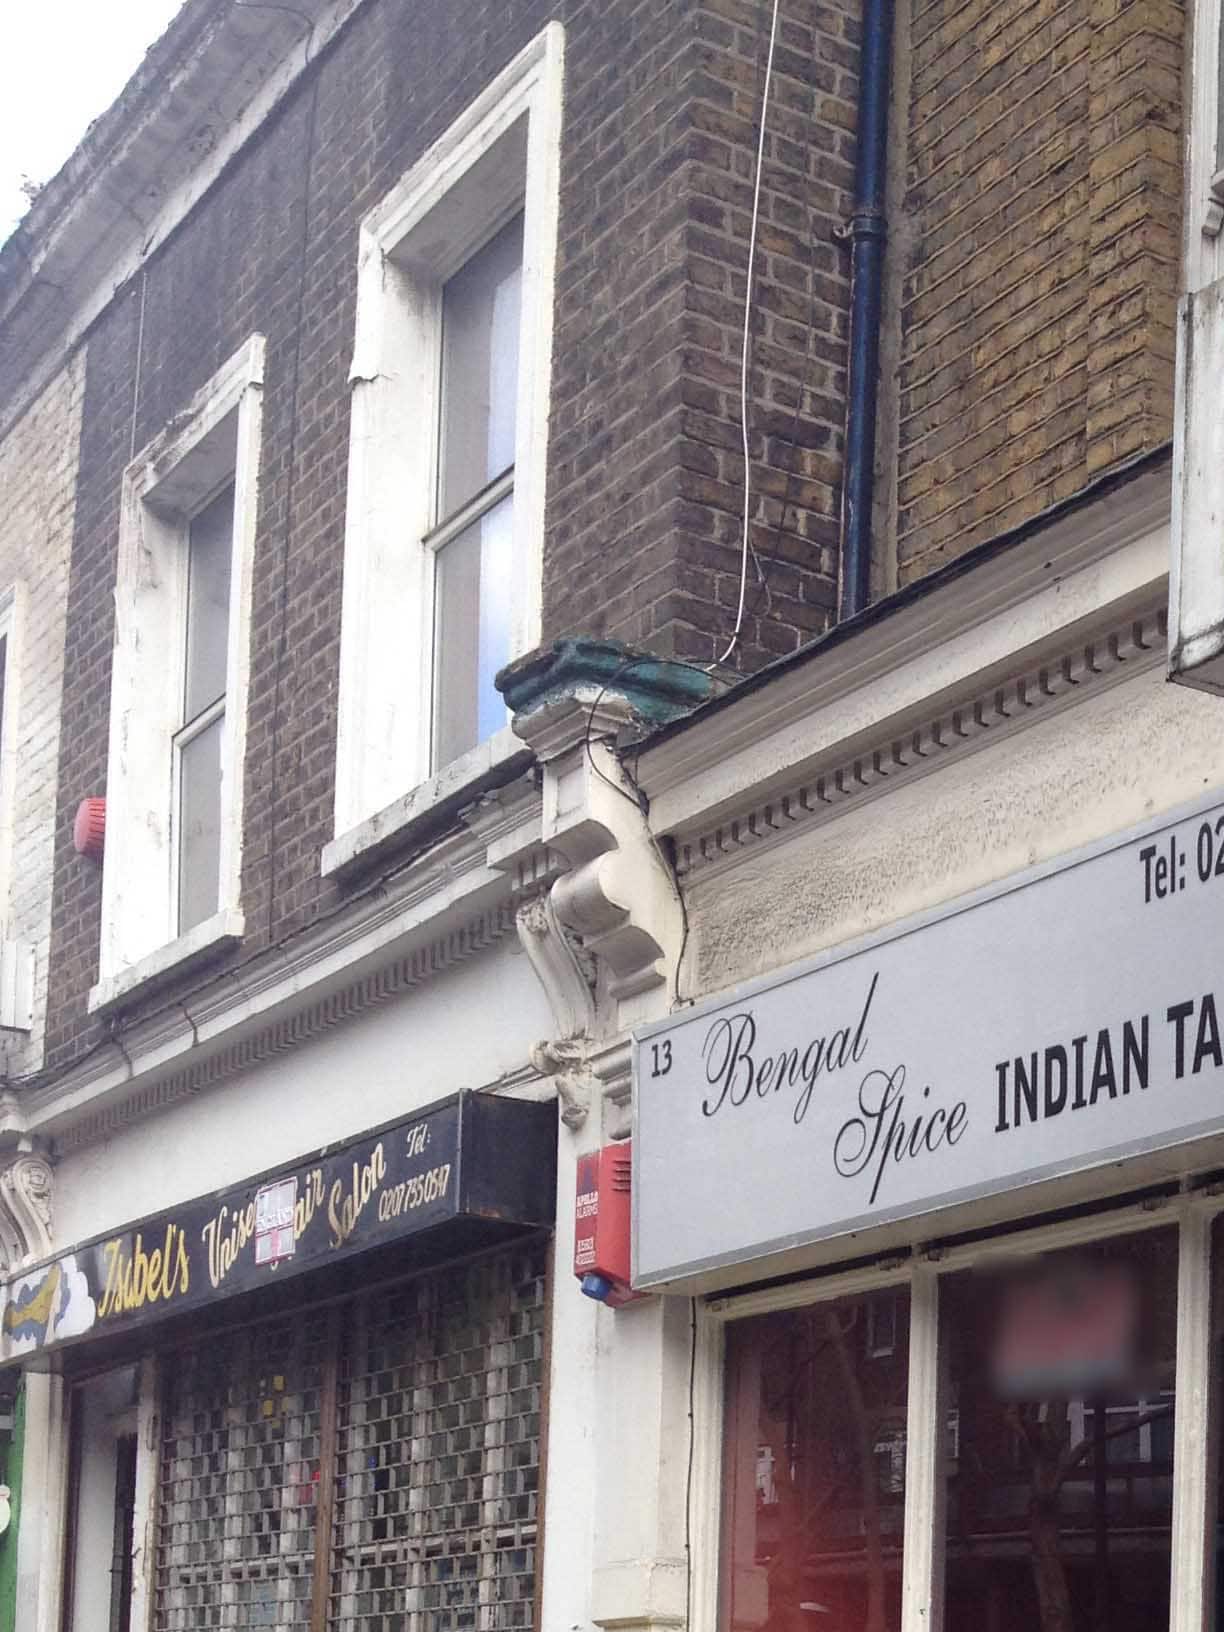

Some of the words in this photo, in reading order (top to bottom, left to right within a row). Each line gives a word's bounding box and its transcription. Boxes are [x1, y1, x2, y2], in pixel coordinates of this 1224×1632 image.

[1139, 834, 1185, 904] Tel:
[651, 1039, 673, 1078] 13
[701, 971, 879, 1124] Bengal
[994, 1014, 1150, 1133] INDIAN
[834, 1064, 968, 1205] Spice
[97, 1223, 191, 1318] Isabel's
[201, 1201, 257, 1289] Unise
[328, 1142, 386, 1250] Salon
[406, 1123, 431, 1158] Tel:
